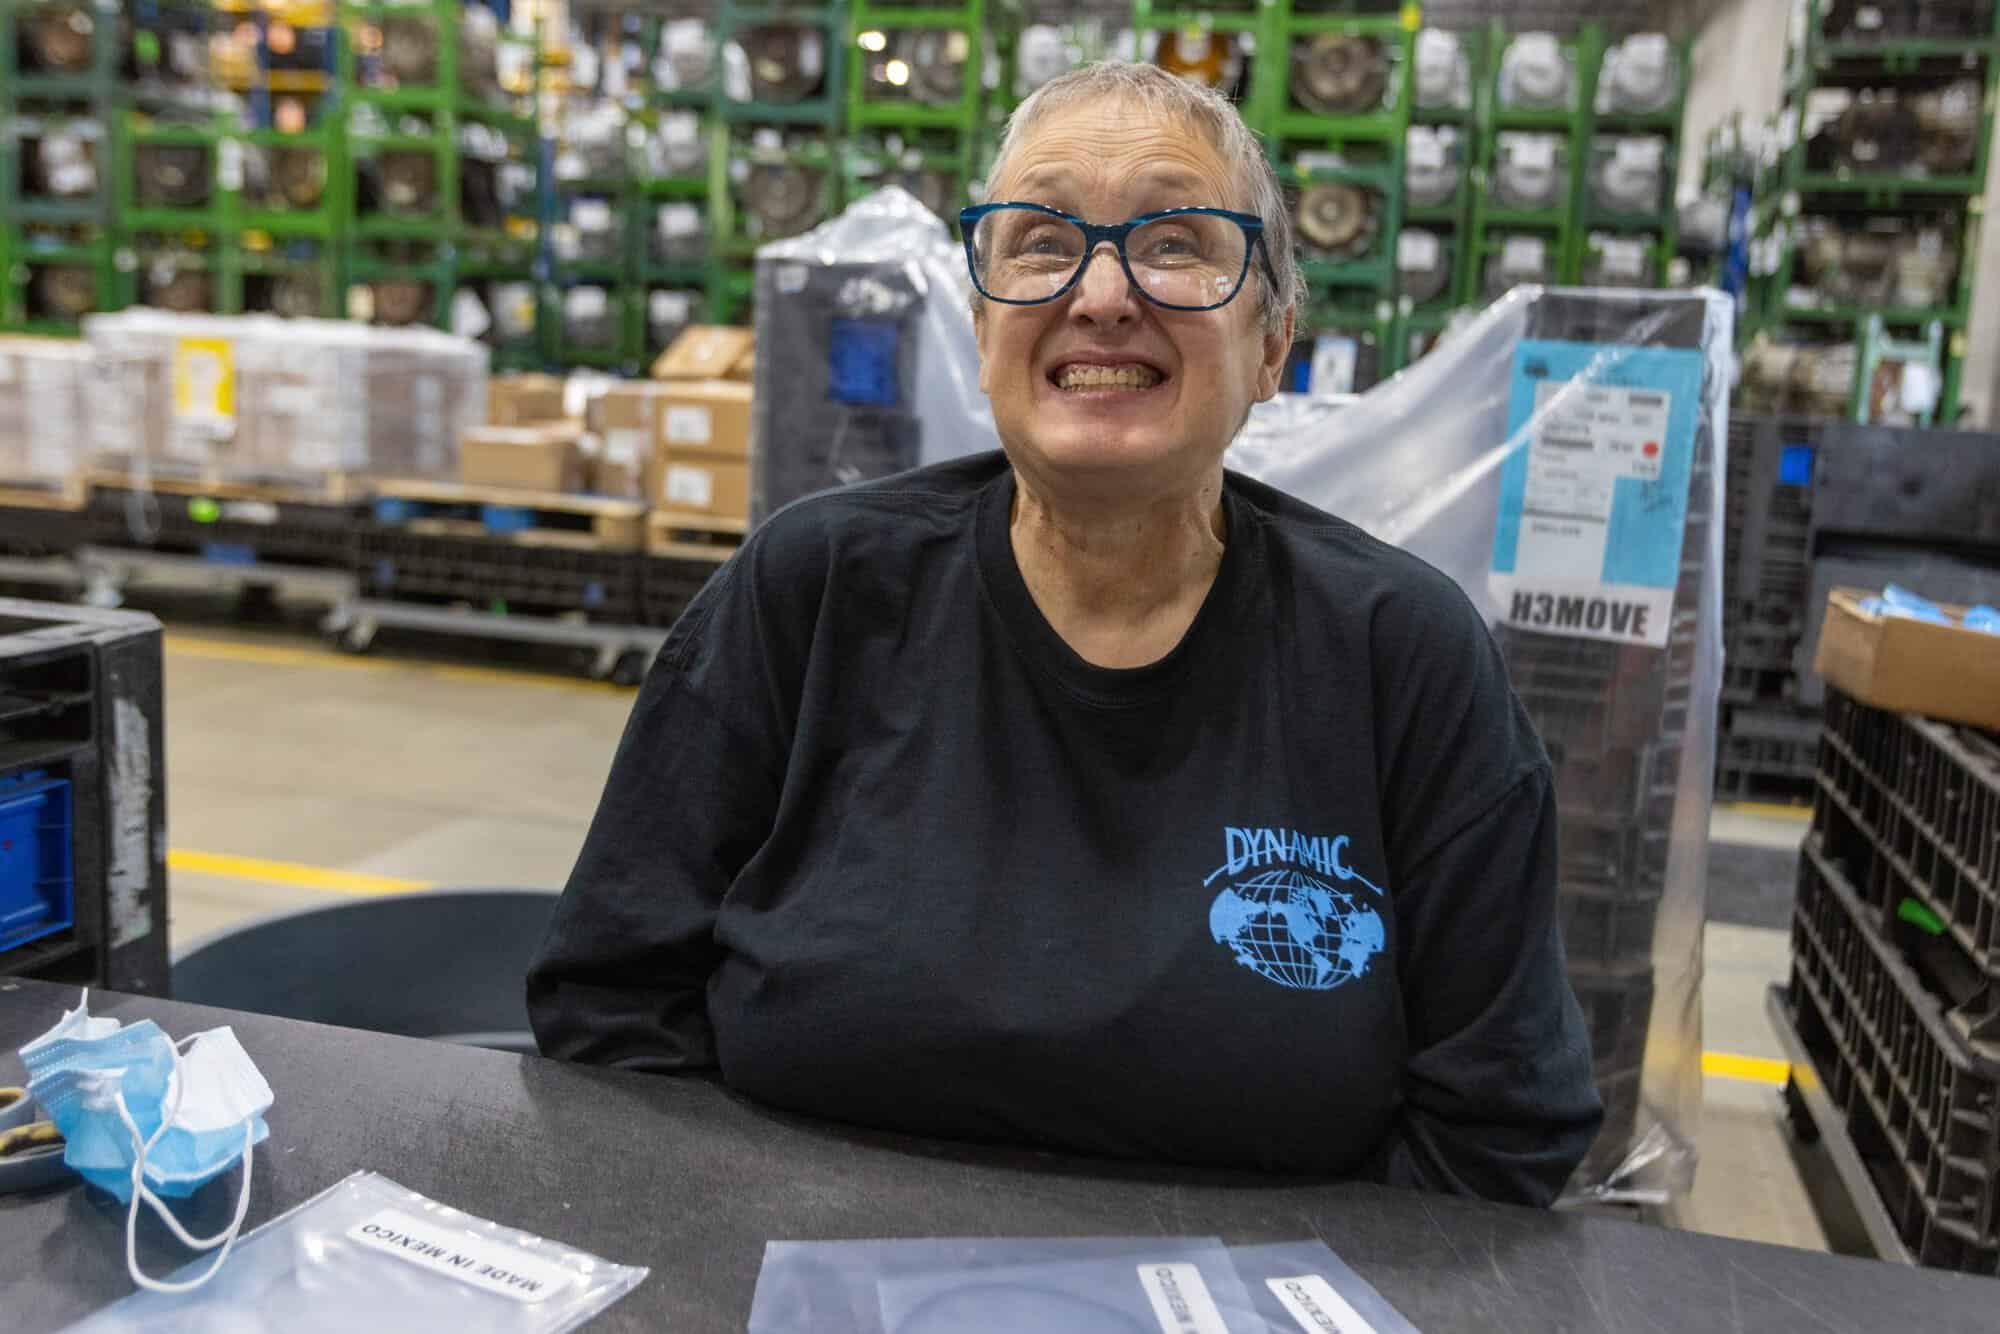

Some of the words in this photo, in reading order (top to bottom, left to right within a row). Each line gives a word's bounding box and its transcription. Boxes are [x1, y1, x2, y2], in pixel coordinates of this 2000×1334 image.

[1509, 590, 1650, 637] H3MOVE
[1224, 827, 1352, 880] DYNAMIC
[361, 1223, 447, 1258] MEXICO
[447, 1254, 476, 1269] IN
[476, 1263, 543, 1292] MADE
[1155, 1267, 1194, 1323] MEXICO
